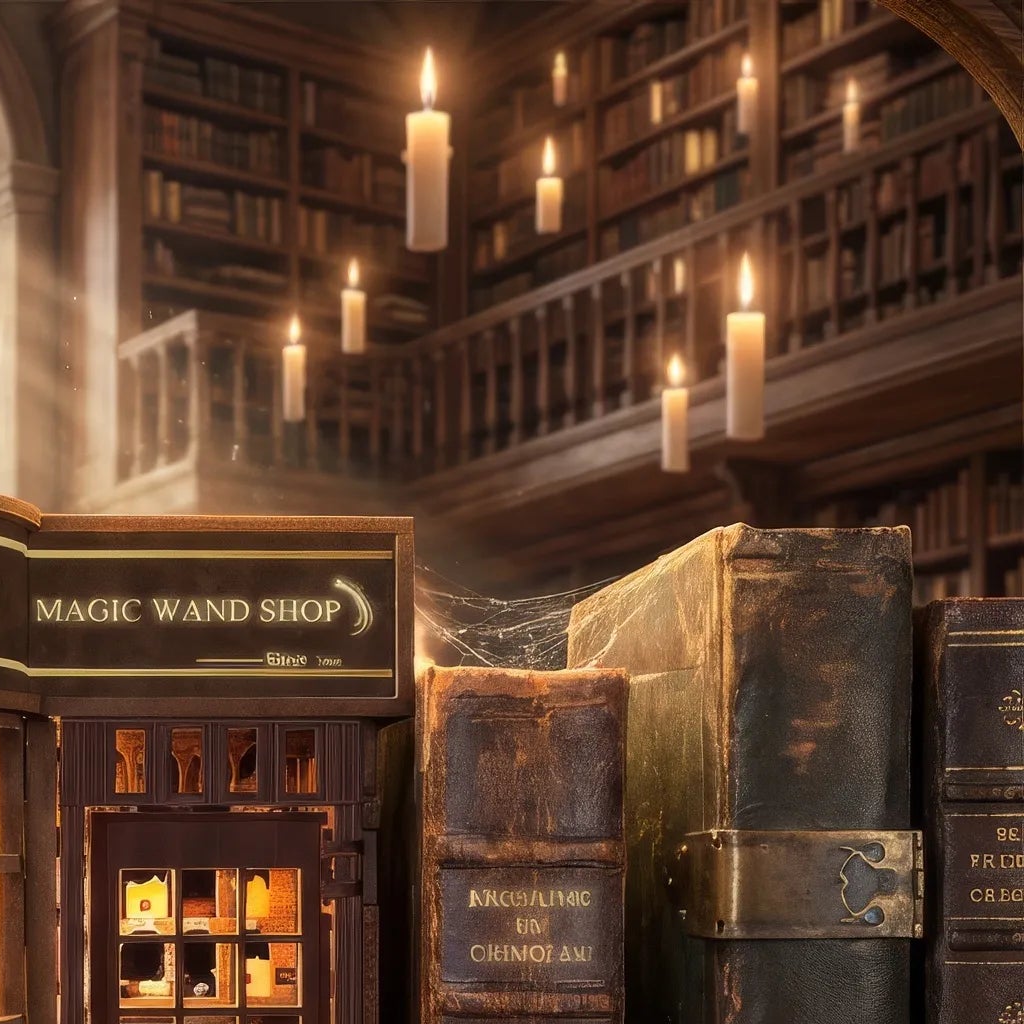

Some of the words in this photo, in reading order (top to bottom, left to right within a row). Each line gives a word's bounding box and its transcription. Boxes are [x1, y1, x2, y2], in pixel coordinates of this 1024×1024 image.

[36, 599, 142, 622] MAGIC
[152, 599, 250, 622] WAND
[259, 598, 341, 622] SHOP
